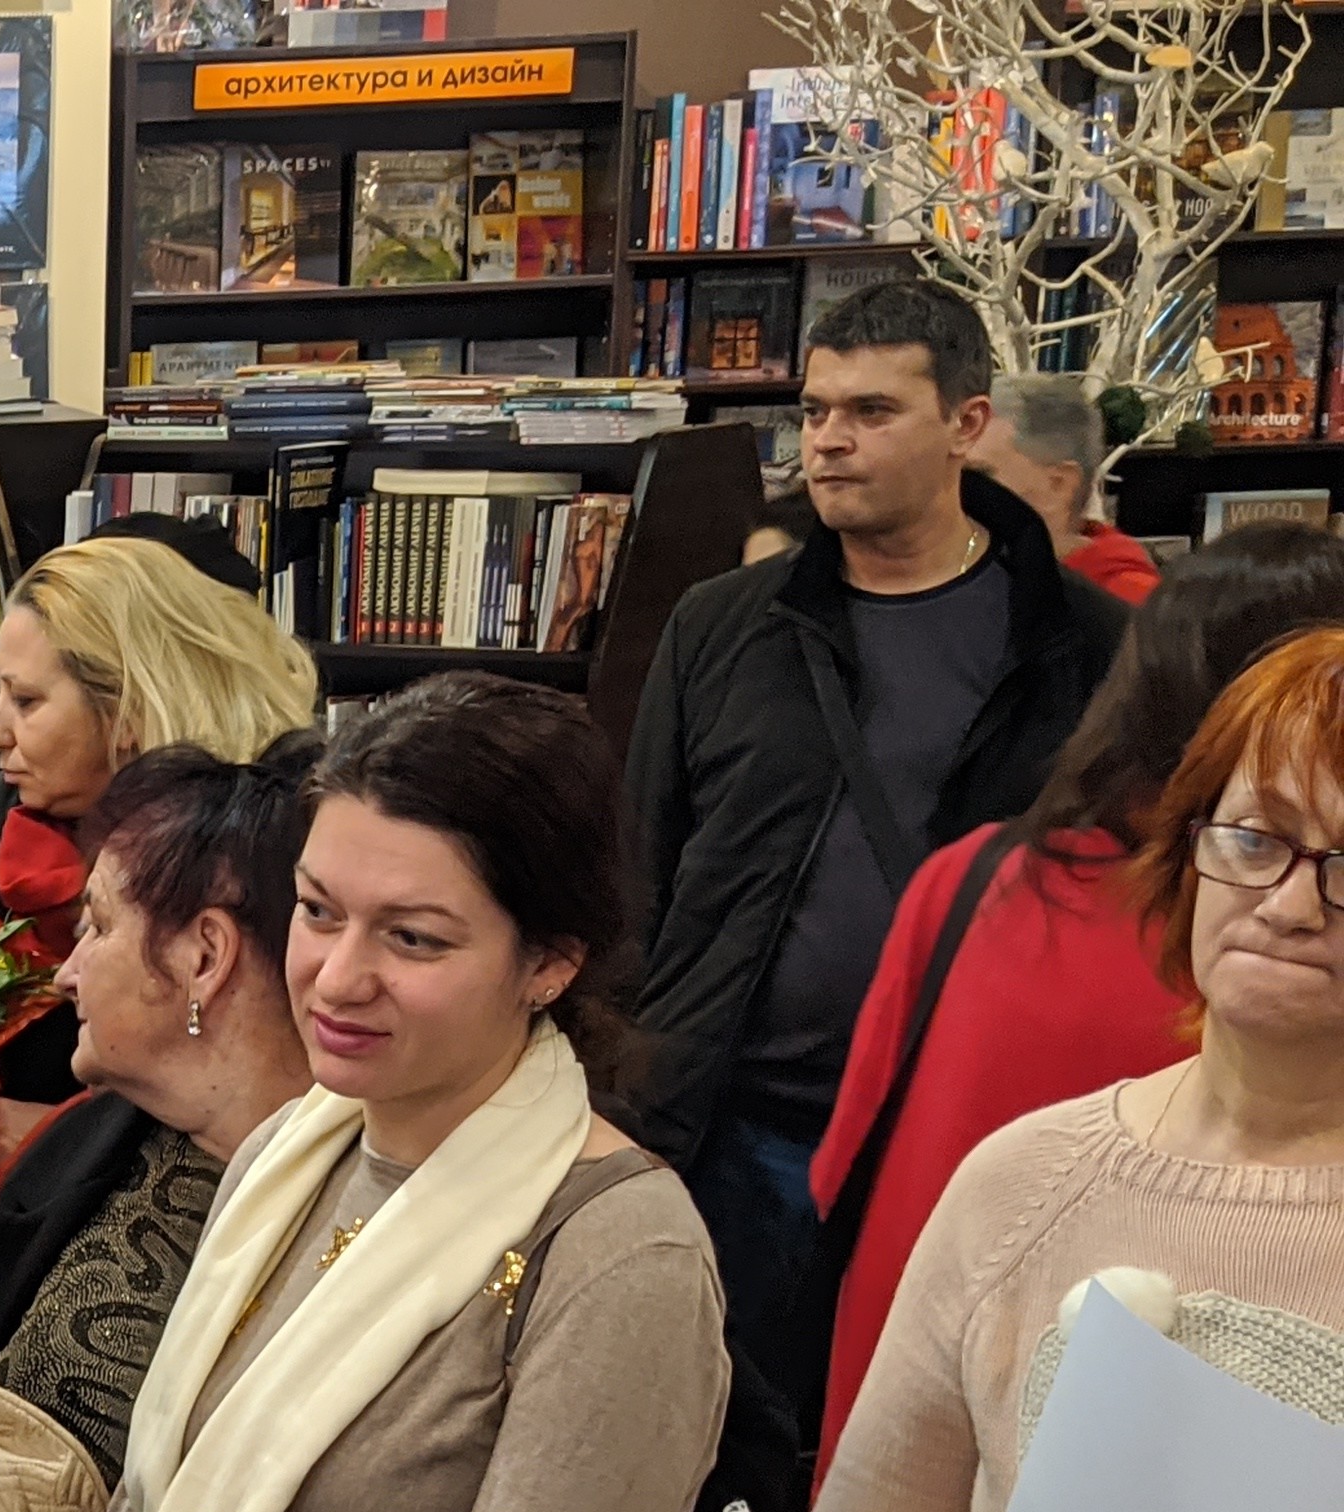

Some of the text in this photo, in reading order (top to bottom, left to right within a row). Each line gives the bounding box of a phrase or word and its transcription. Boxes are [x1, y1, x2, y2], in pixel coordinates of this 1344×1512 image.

[224, 57, 543, 97] архитектура и дизайн
[242, 156, 318, 174] SPACES
[378, 502, 390, 548] ЛЕВЧЕВ
[394, 502, 406, 548] ЛЕВЧЕВ
[1230, 501, 1304, 521] WOOD
[375, 549, 387, 616] ЛЮБОМИР
[389, 549, 402, 616] ЛЮБОМИР
